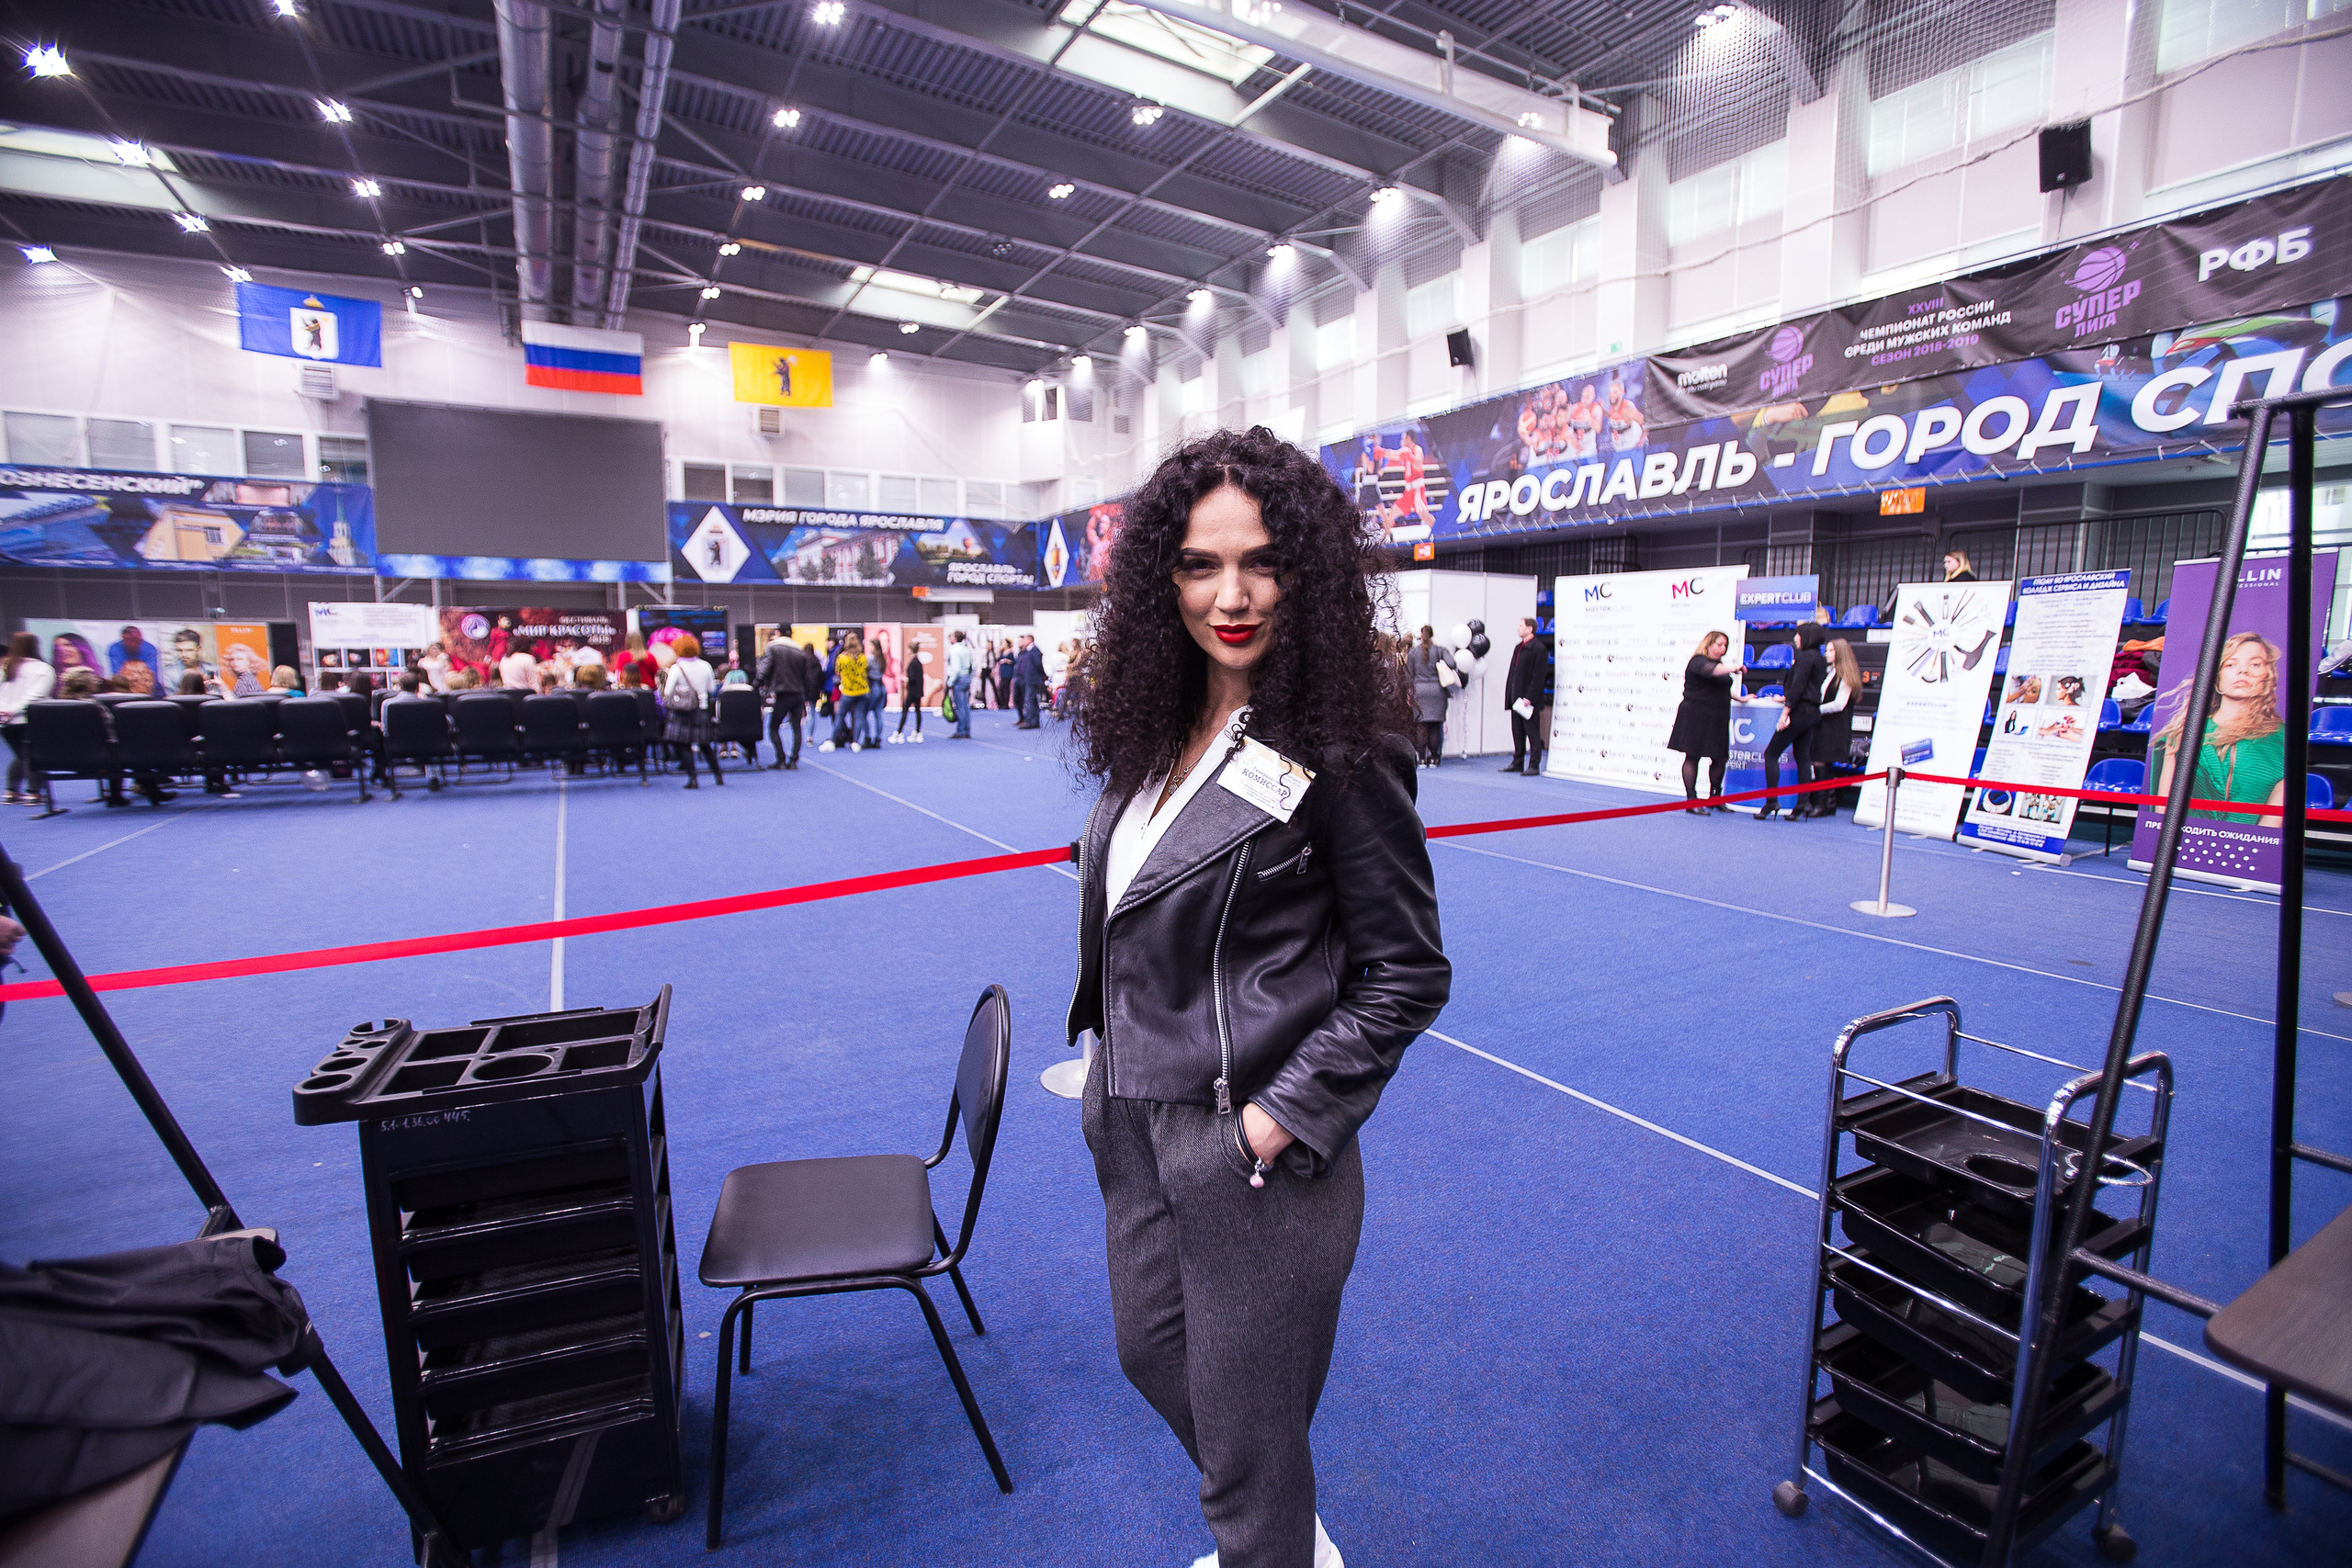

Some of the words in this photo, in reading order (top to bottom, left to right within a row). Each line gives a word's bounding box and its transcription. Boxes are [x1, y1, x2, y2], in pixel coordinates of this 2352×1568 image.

[2198, 227, 2313, 283] РФБ
[1907, 297, 1944, 315] XXVIII
[2054, 279, 2142, 330] СУПЕР
[1860, 312, 1936, 340] ЧЕМПИОНАТ
[1938, 299, 1996, 322] РОССИИ
[2074, 311, 2117, 338] ЛИГА
[1844, 341, 1885, 358] СРЕДИ
[1886, 324, 1950, 350] МУЖСКИХ
[1951, 311, 2011, 334] КОМАНД
[1871, 347, 1912, 367] СЕЗОН
[1914, 334, 1980, 357] 2018-2019
[1678, 364, 1728, 387] molten
[1759, 354, 1814, 391] СУПЕР
[1455, 440, 1757, 524] ЯРОСЛАВЛЬ
[1811, 381, 2103, 476] ГОРОД
[742, 508, 797, 524] МЭРИЯ
[798, 511, 858, 528] ГОРОДА
[859, 514, 944, 532] ЯРОСЛАВЛЯ
[1671, 577, 1704, 599] MC
[2238, 569, 2281, 582] LIN
[1585, 582, 1612, 602] MC
[1241, 768, 1288, 796] КОМИССАР
[2219, 830, 2279, 845] ОЖИДАНИЯ
